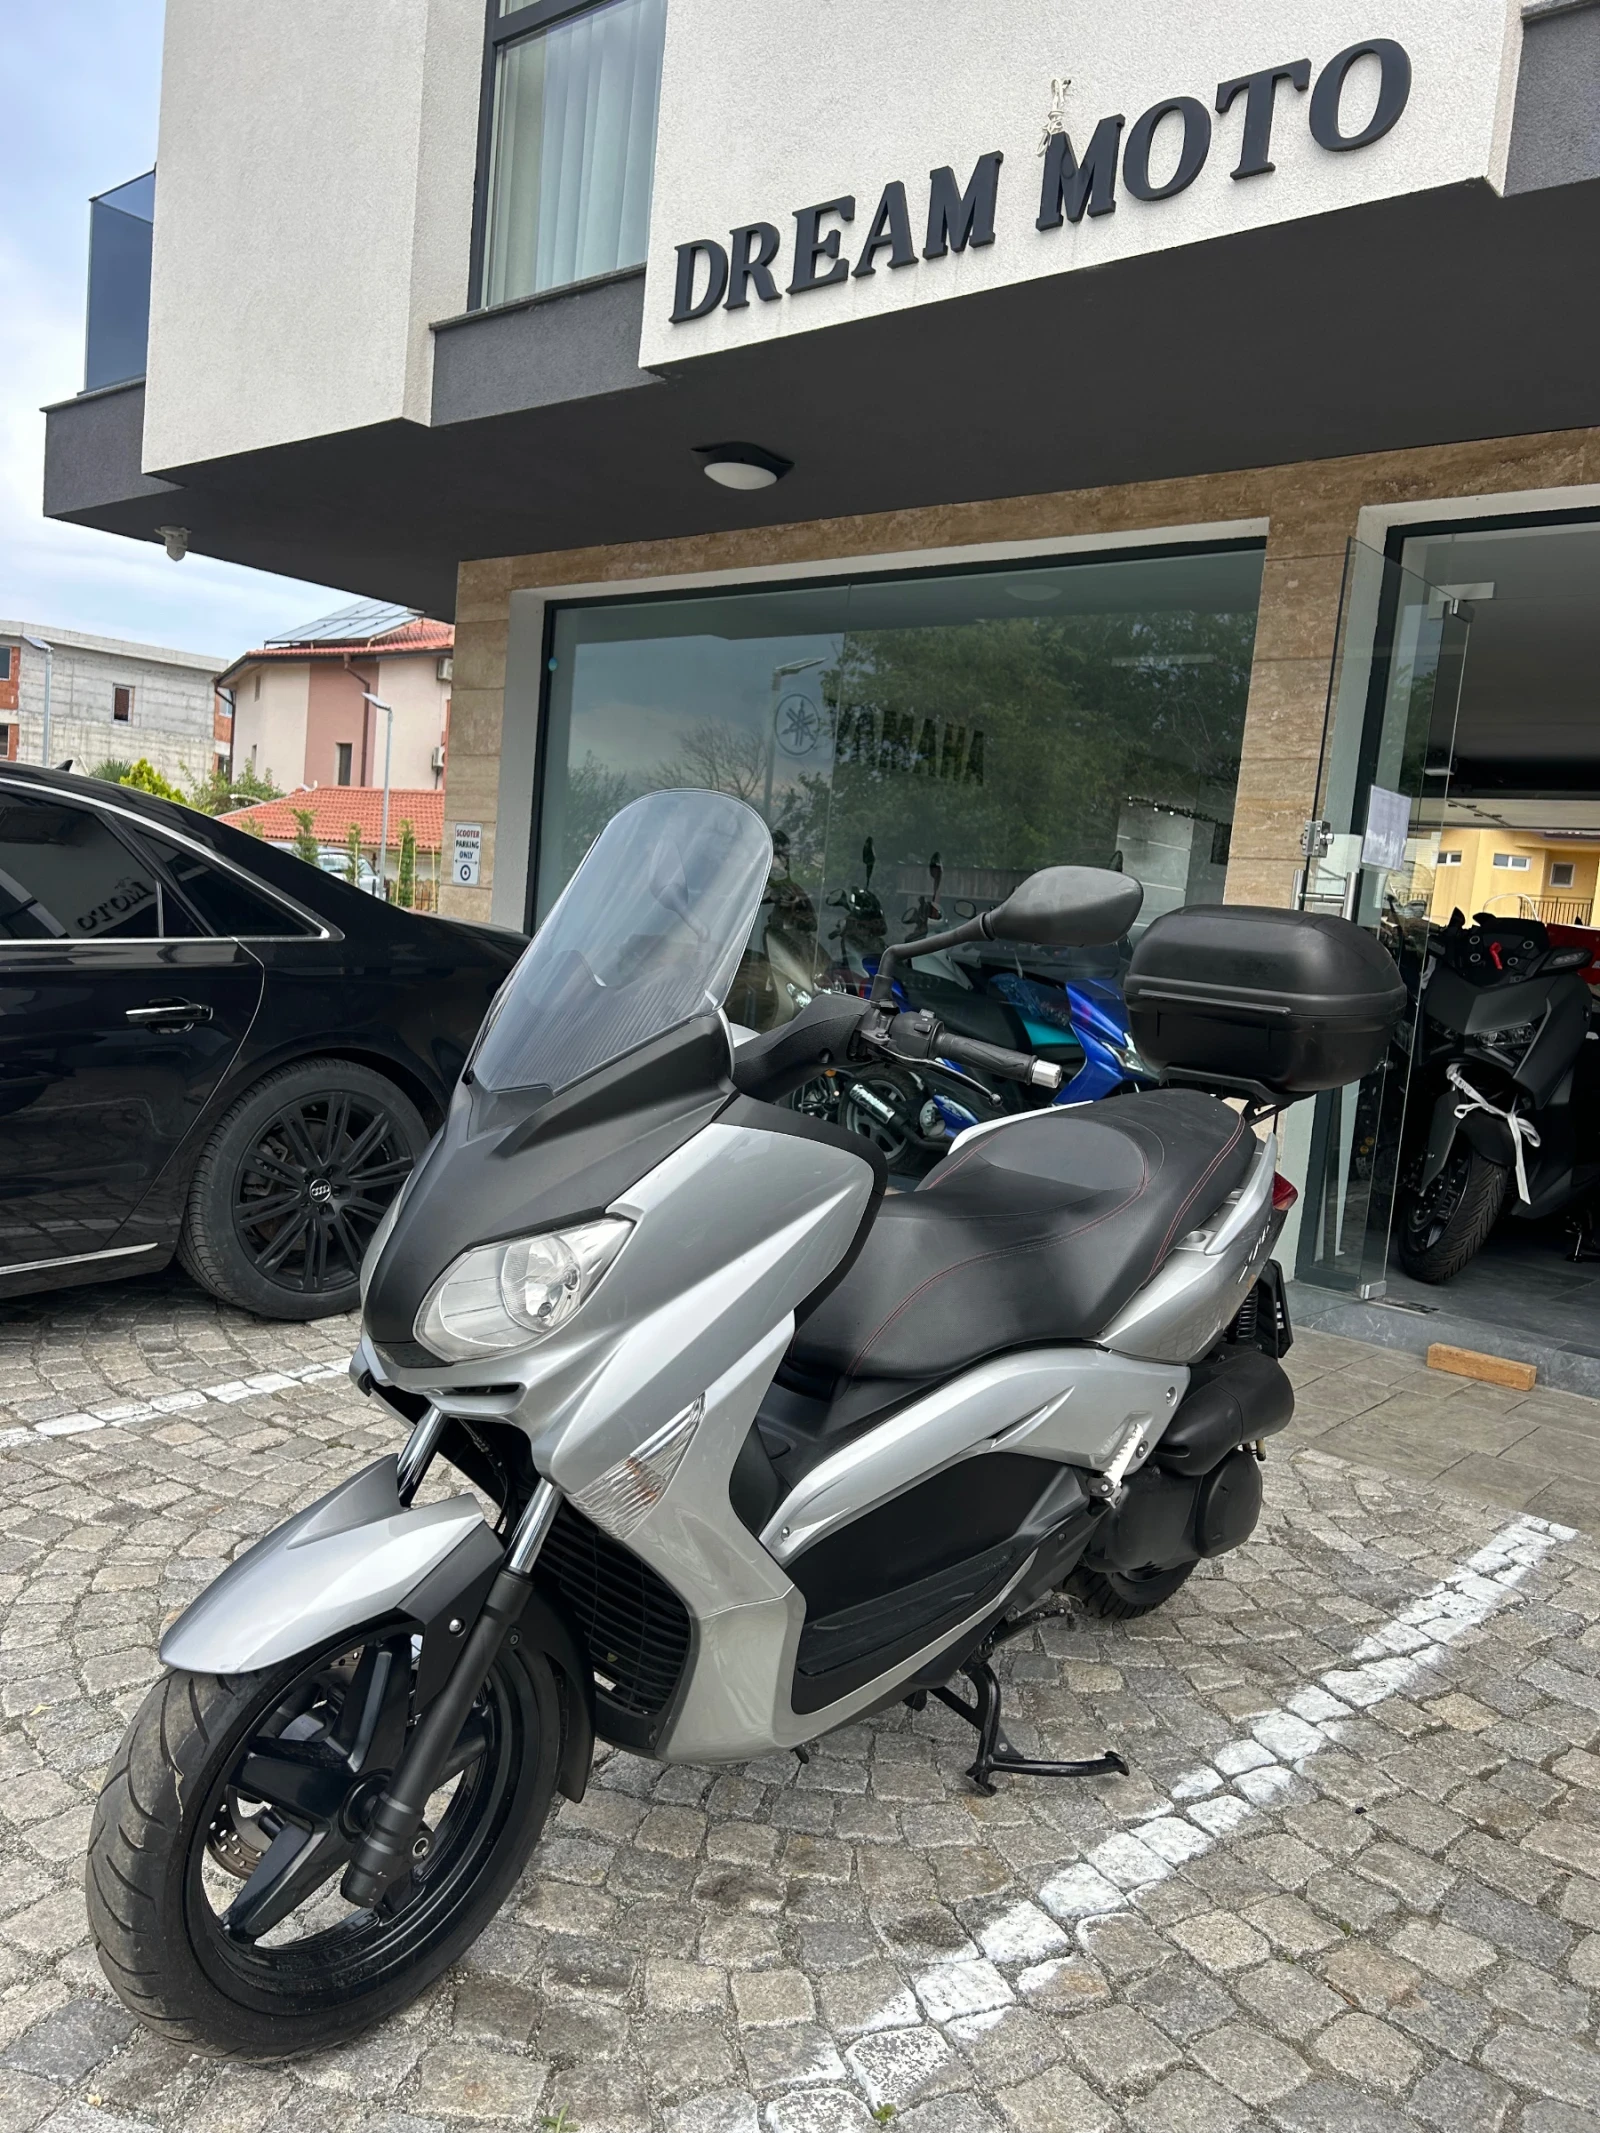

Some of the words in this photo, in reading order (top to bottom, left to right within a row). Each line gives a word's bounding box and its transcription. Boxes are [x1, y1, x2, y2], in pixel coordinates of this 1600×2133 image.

[669, 151, 1004, 325] DREAM
[1036, 38, 1413, 232] MOTO
[827, 698, 985, 787] YAMAHA
[456, 829, 480, 838] SCOOTER
[456, 840, 479, 849] PARKING
[459, 851, 473, 859] ONLY
